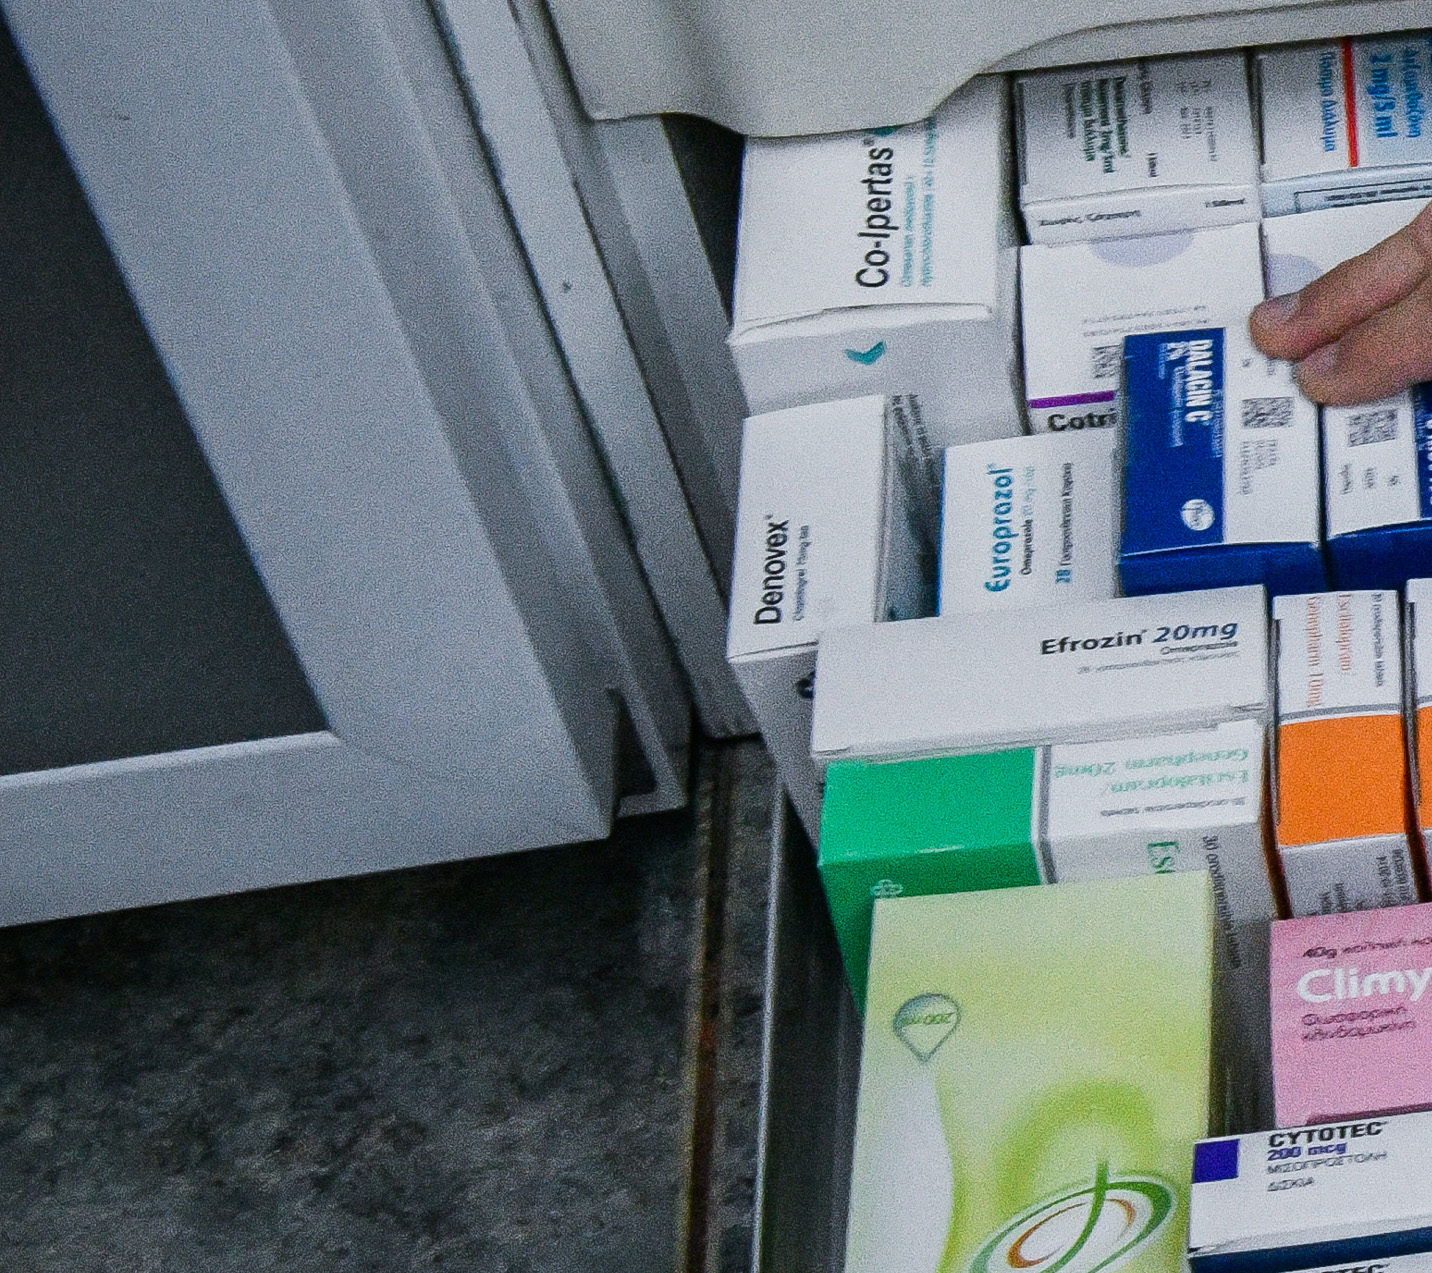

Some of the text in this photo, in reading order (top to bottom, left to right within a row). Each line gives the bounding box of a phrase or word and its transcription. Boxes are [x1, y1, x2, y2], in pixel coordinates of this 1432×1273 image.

[854, 147, 900, 289] Co-Ipertas
[1180, 339, 1212, 407] DALACIN
[753, 520, 788, 625] Denovex
[1040, 622, 1239, 655] Efrozin 20mg
[1265, 1141, 1348, 1161] 200 mcg
[1268, 1121, 1382, 1148] CYTOTEC
